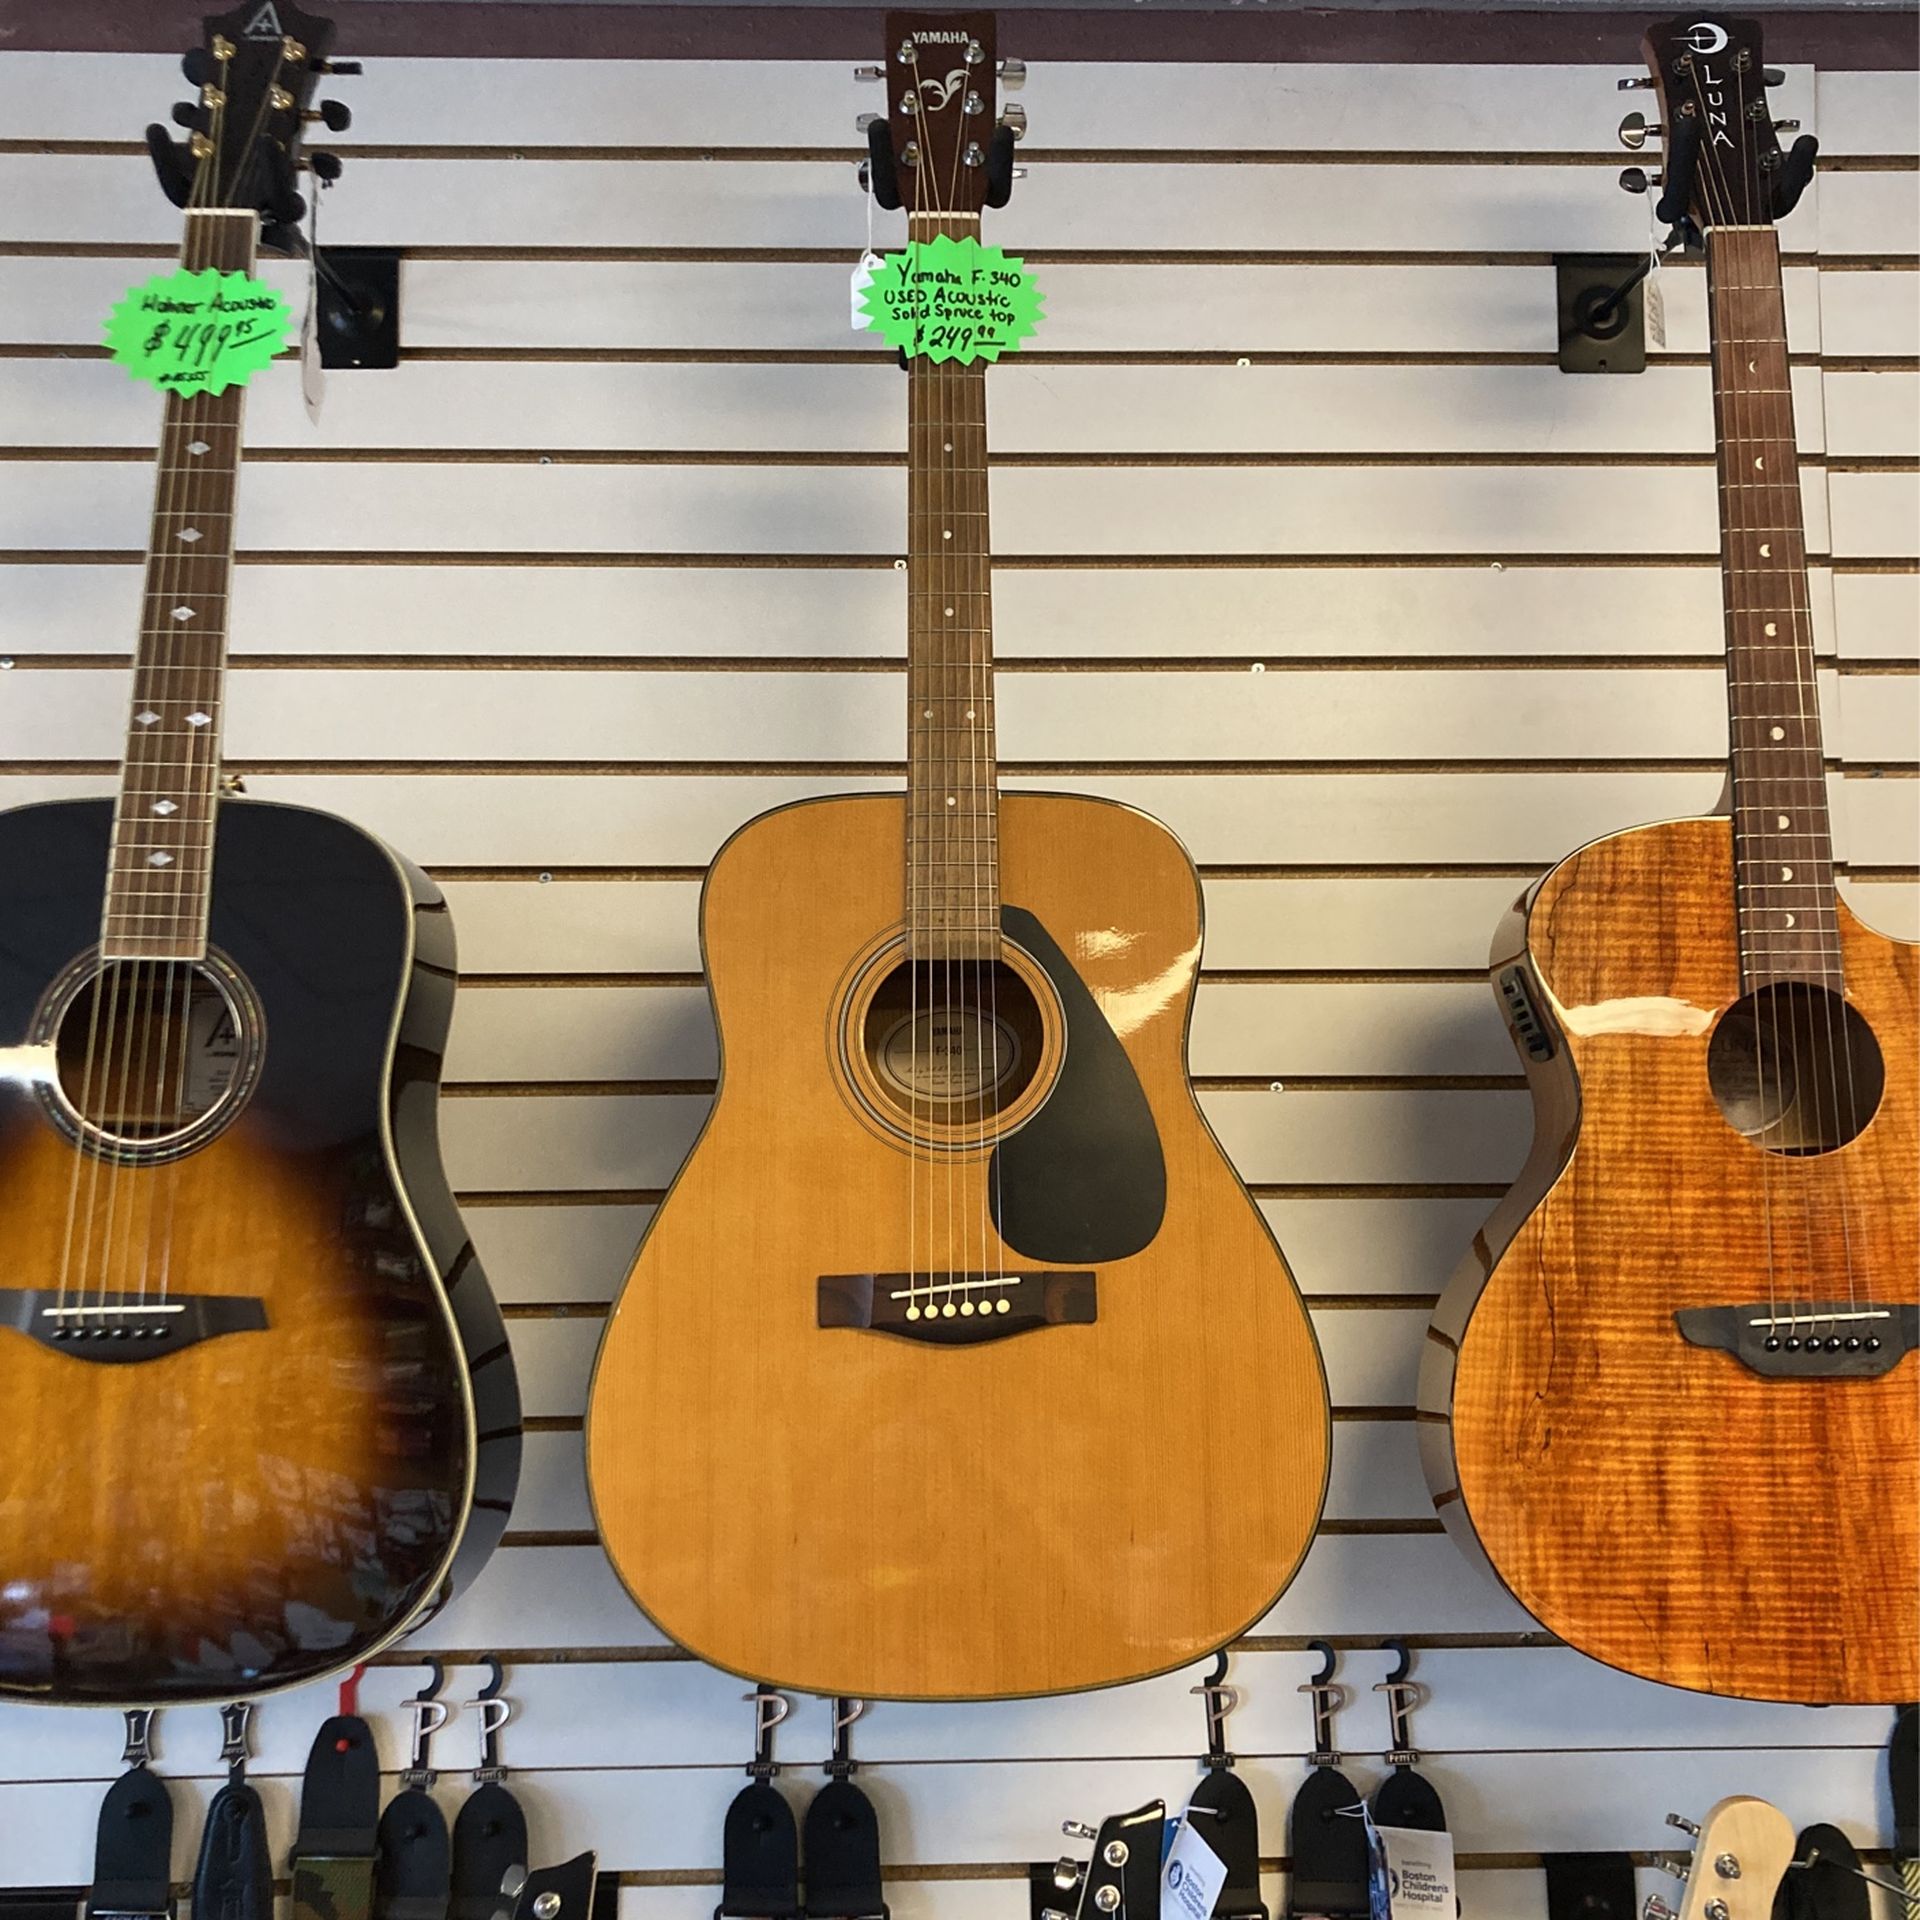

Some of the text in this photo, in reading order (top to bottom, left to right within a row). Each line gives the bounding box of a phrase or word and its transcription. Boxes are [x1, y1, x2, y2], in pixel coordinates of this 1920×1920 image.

[912, 32, 969, 44] YAMAHA
[1704, 65, 1735, 148] LUNA
[897, 258, 962, 287] Yamaha
[884, 287, 1011, 308] USED Acoustic
[892, 304, 1015, 326] Solid Spruce top
[1402, 1870, 1436, 1882] Boston
[1402, 1880, 1449, 1894] Children's
[1403, 1890, 1443, 1904] Hospital
